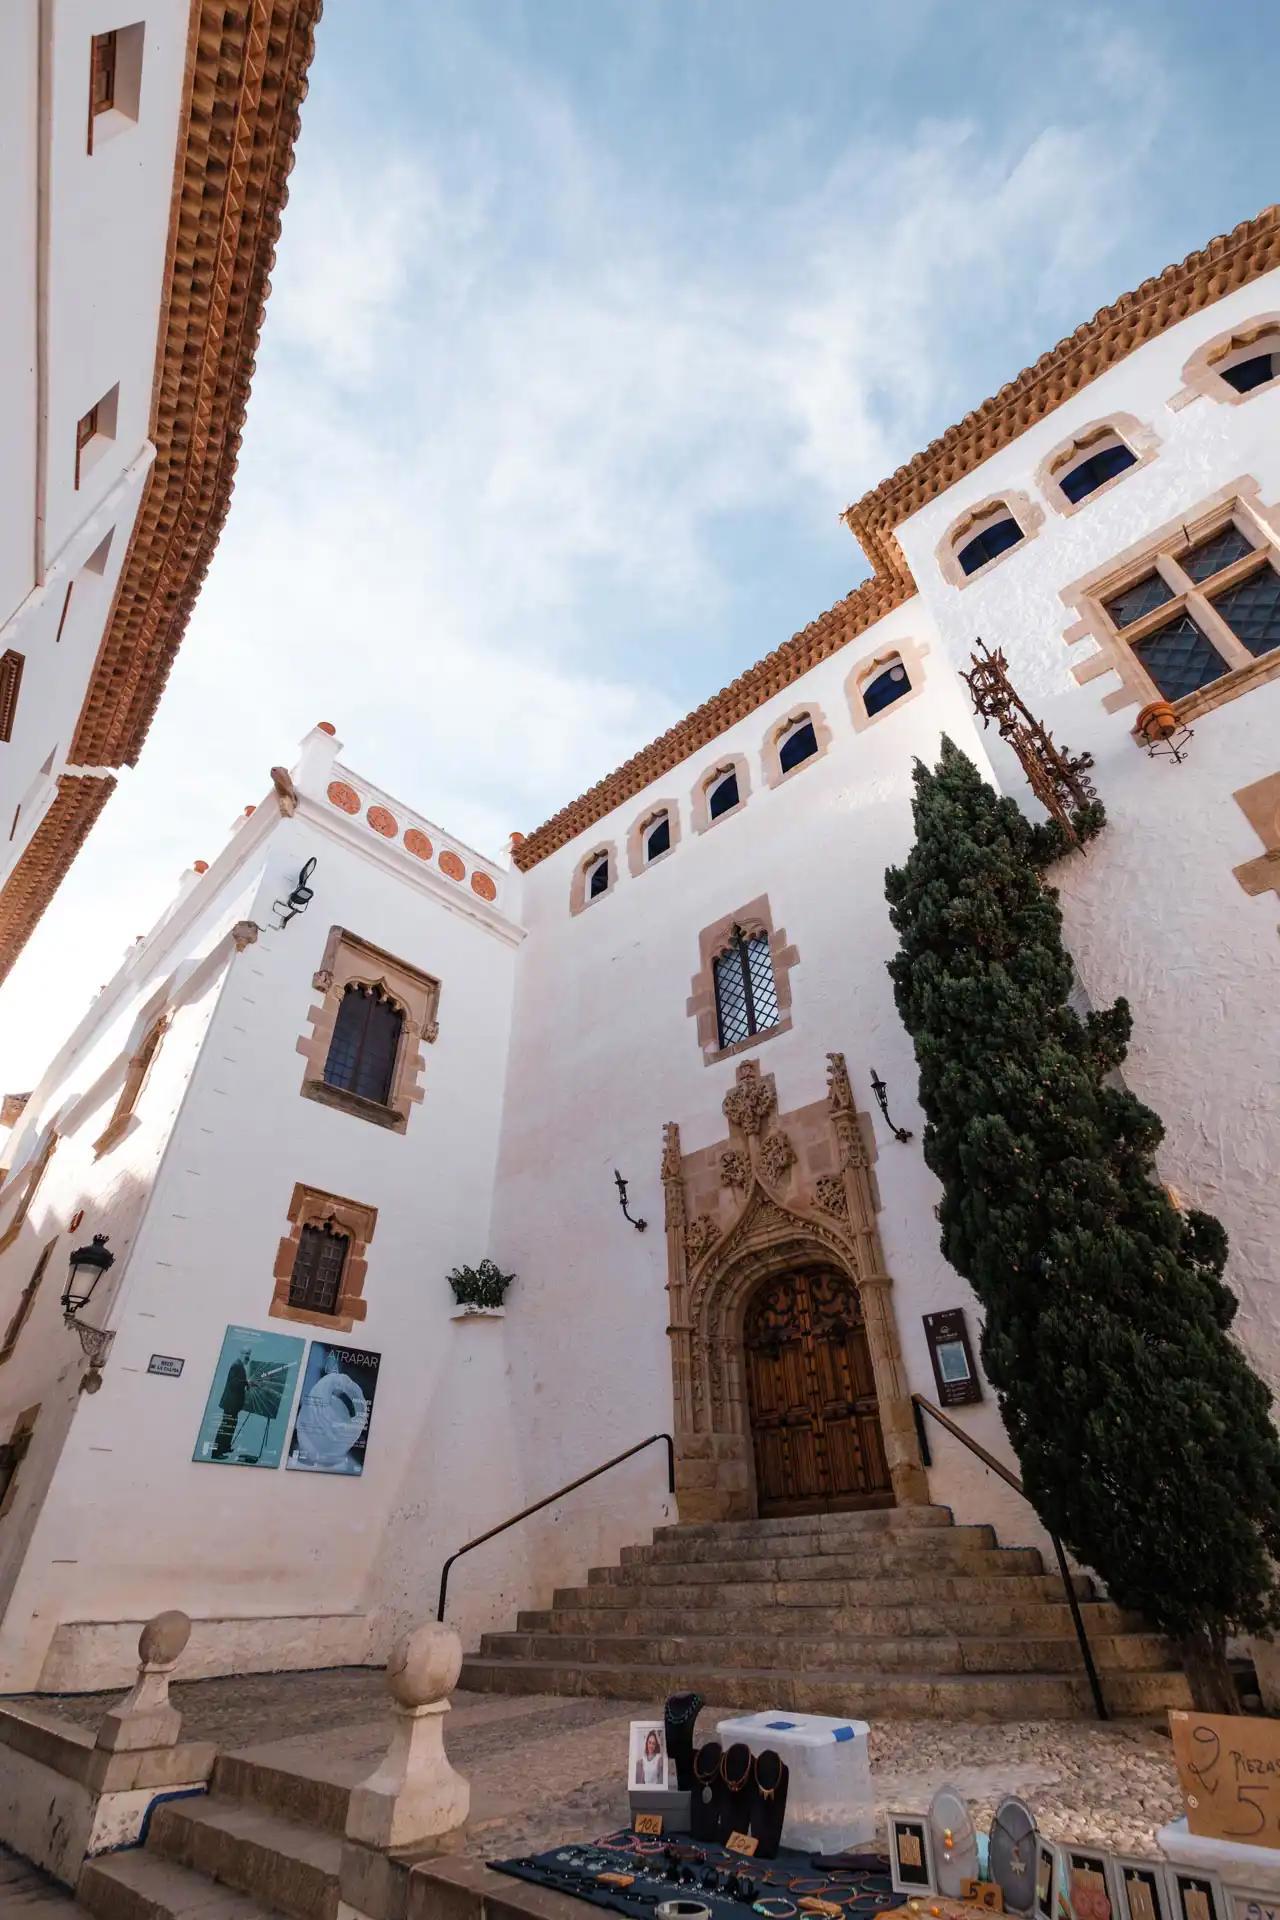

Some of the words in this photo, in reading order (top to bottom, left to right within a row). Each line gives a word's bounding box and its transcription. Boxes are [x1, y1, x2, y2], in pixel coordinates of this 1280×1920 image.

[327, 1349, 379, 1369] ATRAPAR
[1187, 1726, 1221, 1795] 2
[1222, 1786, 1270, 1836] 5
